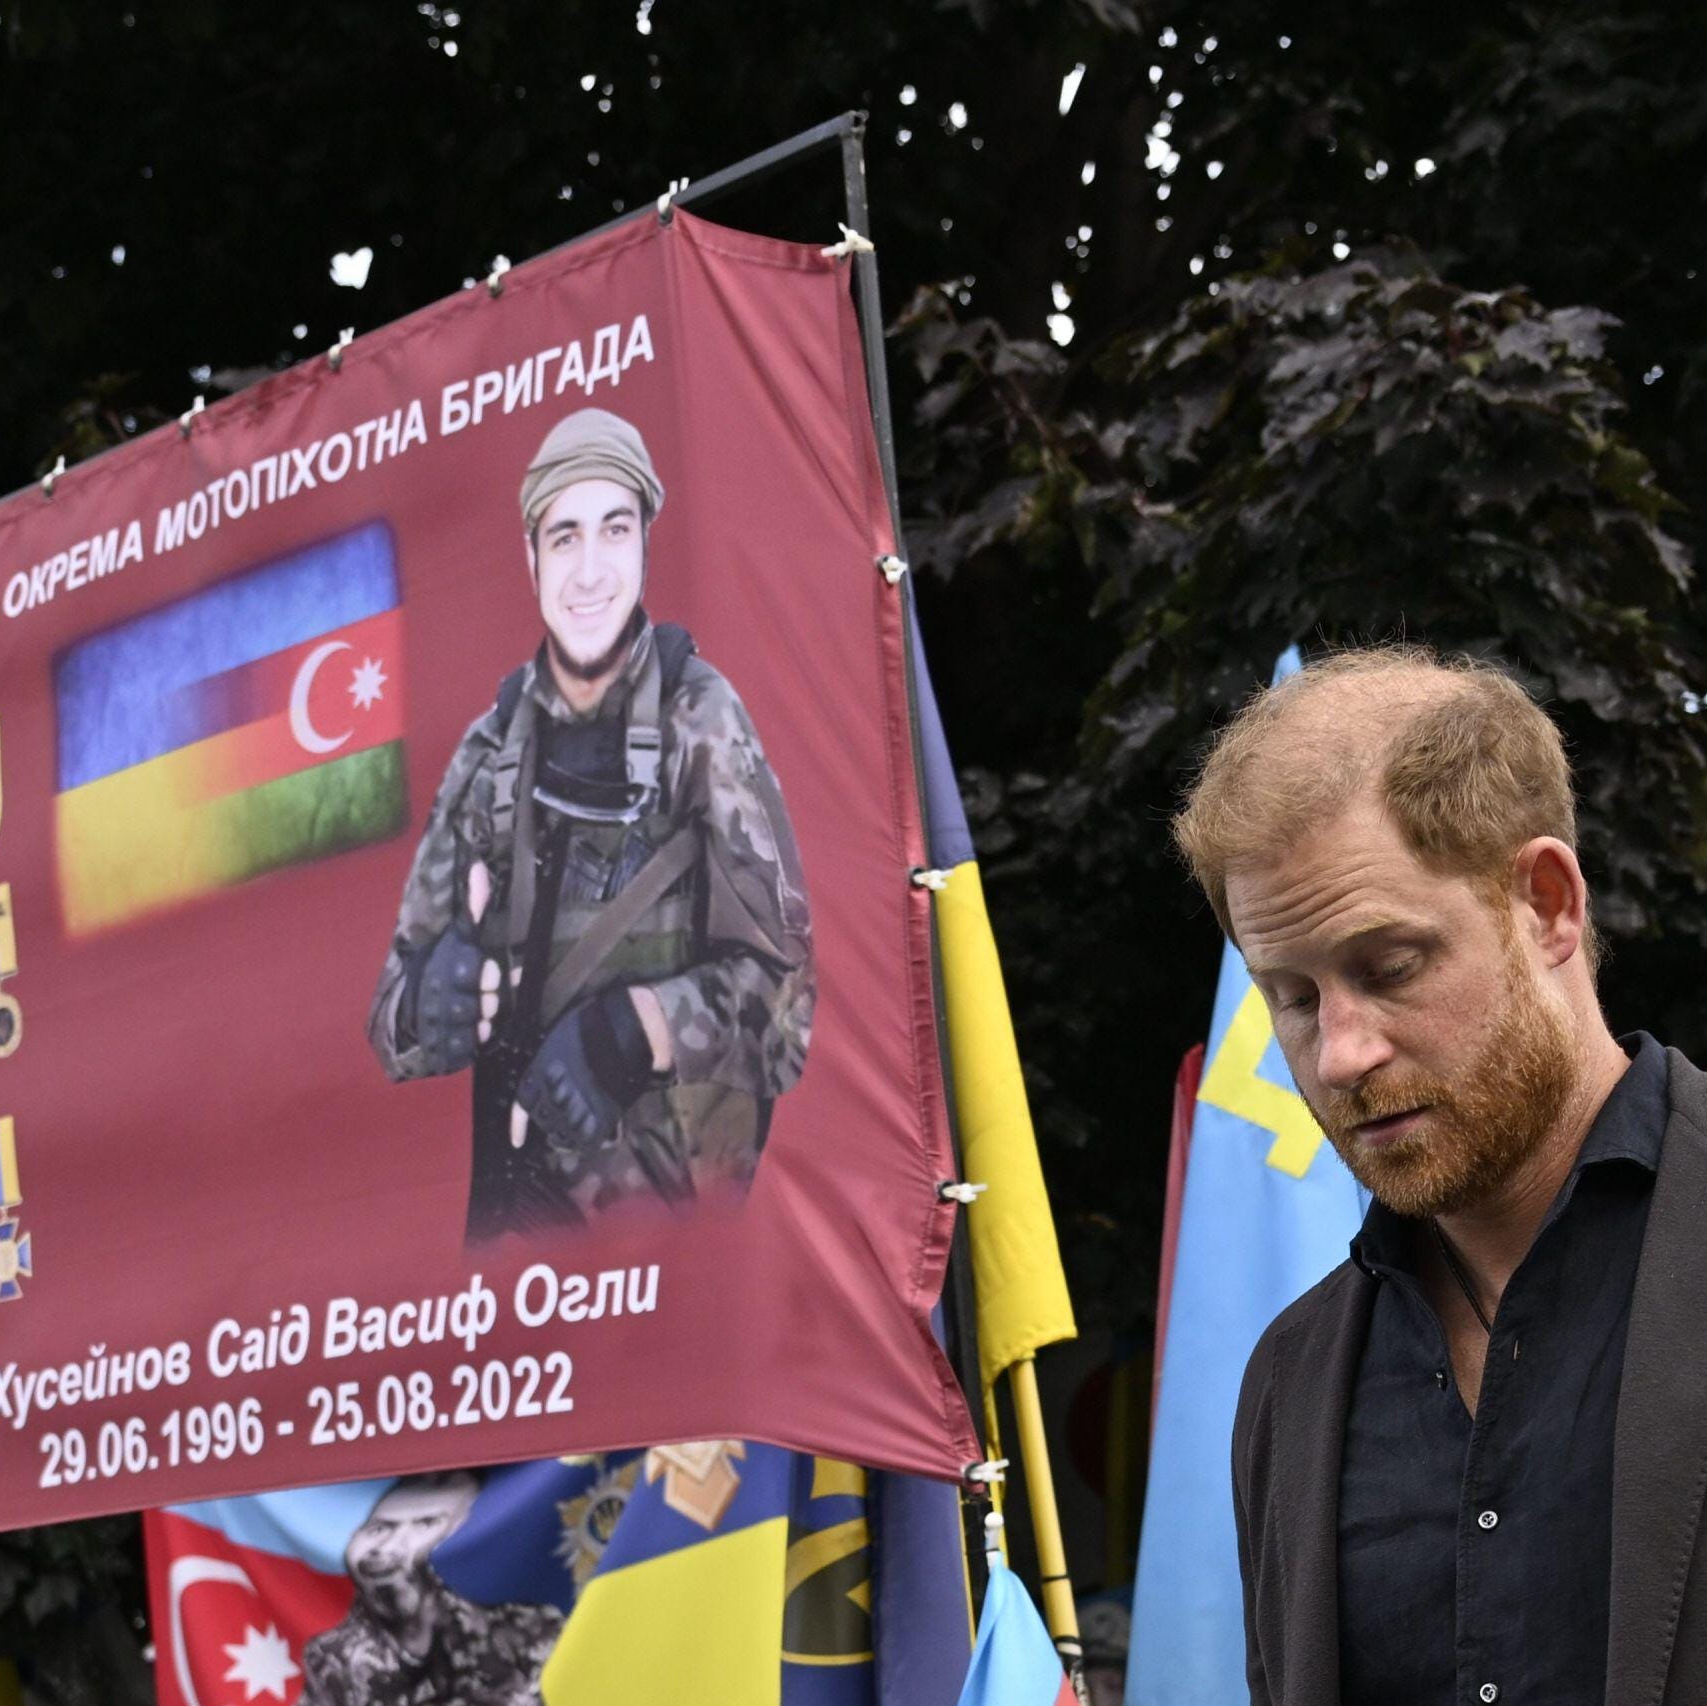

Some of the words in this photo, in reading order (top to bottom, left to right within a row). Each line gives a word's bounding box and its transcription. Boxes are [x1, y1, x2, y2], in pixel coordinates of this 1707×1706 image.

[2, 520, 144, 618] ОКРЕМА
[153, 399, 428, 555] МОТОПІХОТНА
[440, 314, 655, 436] БРИГАДА
[207, 1303, 310, 1378] Саід
[323, 1273, 497, 1359] Васиф
[514, 1263, 661, 1328] Огли
[39, 1396, 264, 1488] 29.06.1996
[277, 1420, 294, 1435] -
[308, 1351, 574, 1445] 25.08.2022
